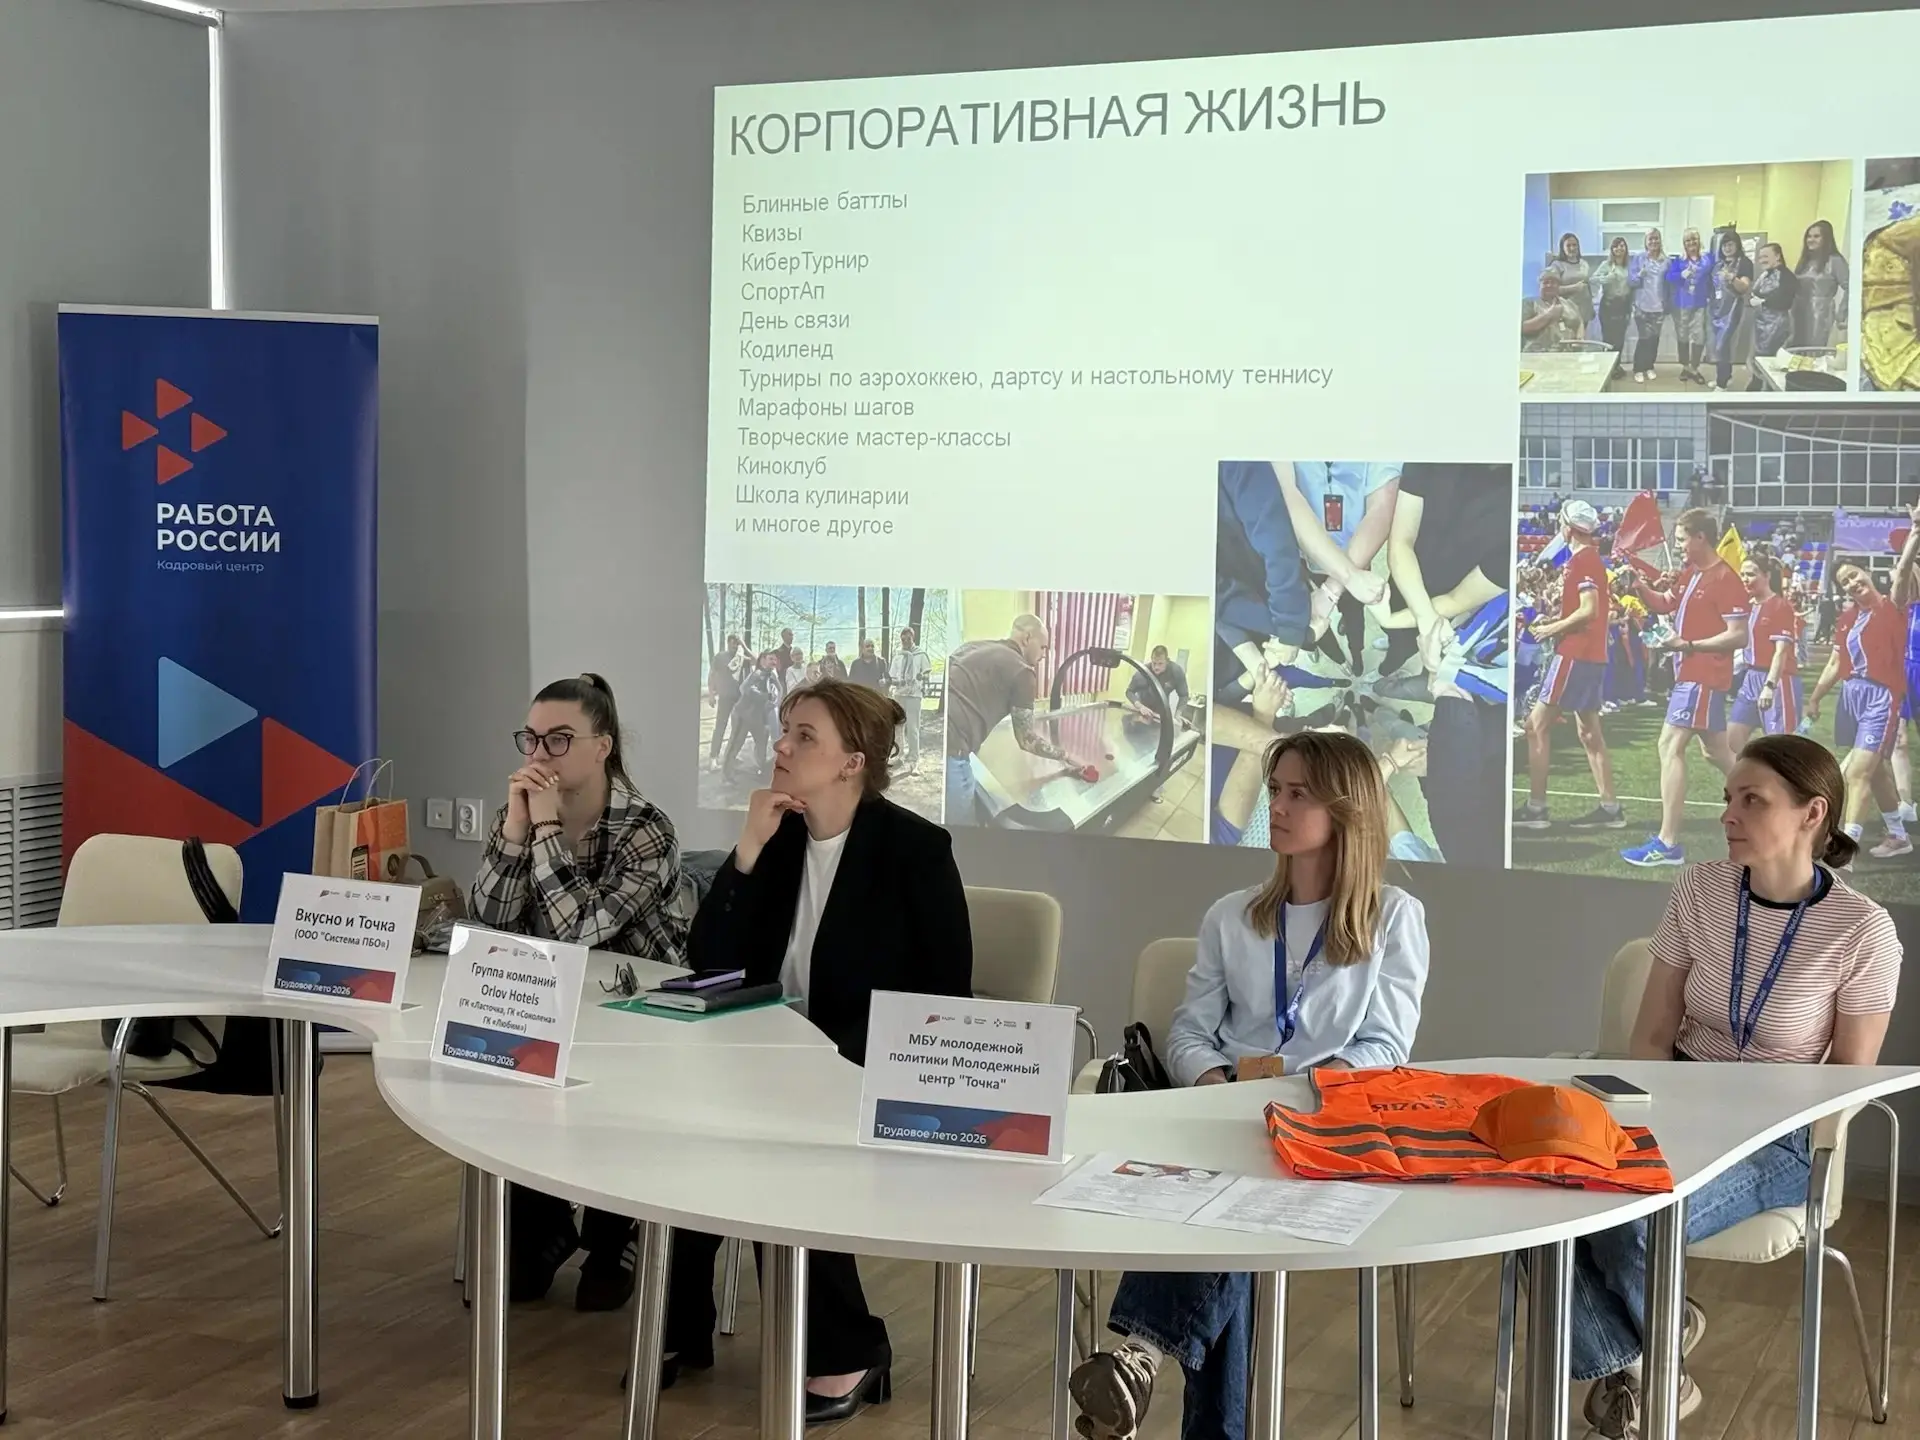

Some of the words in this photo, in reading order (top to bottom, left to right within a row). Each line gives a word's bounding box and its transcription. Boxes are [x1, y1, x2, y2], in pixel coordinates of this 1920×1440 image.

[730, 91, 1168, 156] КОРПОРАТИВНАЯ
[1184, 80, 1387, 135] ЖИЗНЬ
[743, 194, 829, 214] Блинные
[838, 190, 908, 211] баттлы
[742, 223, 803, 244] Квизы
[741, 250, 870, 276] КиберТурнир
[741, 280, 825, 305] СпортАп
[739, 310, 789, 335] День
[794, 312, 850, 330] связи
[740, 339, 834, 363] Кодиленд
[738, 369, 822, 393] Турниры
[829, 372, 853, 389] по
[860, 370, 983, 392] аэрохоккею,
[991, 370, 1064, 391] дартсу
[1071, 370, 1083, 385] и
[1091, 367, 1235, 390] настольному
[1241, 367, 1334, 389] теннису
[738, 397, 847, 422] Марафоны
[854, 401, 915, 417] шагов
[737, 426, 849, 451] Творческие
[856, 430, 1011, 451] мастер-классы
[737, 455, 828, 480] Киноклуб
[735, 484, 800, 505] Школа
[805, 488, 909, 510] кулинарии
[157, 502, 275, 527] РАБОТА
[157, 529, 280, 552] РОССИИ
[735, 517, 746, 533] и
[753, 517, 821, 534] многое
[826, 518, 894, 540] другое
[157, 559, 223, 573] Кадровый
[226, 562, 265, 574] центр
[295, 907, 342, 926] Вкусно
[345, 917, 355, 927] и
[359, 915, 396, 933] Точка
[294, 928, 319, 940] (ООО
[320, 931, 361, 946] "Система
[276, 978, 313, 991] Трудовое
[313, 984, 332, 994] лето
[332, 985, 352, 996] 2026
[471, 962, 505, 979] Группа
[506, 970, 558, 989] компаний
[481, 984, 508, 1000] Orlov
[508, 988, 541, 1006] Hotels
[444, 1043, 479, 1059] Трудовое
[478, 1052, 496, 1063] лето
[496, 1055, 515, 1067] 2026
[908, 1033, 938, 1047] МБУ
[940, 1037, 1024, 1055] молодежной
[889, 1052, 949, 1066] политики
[951, 1056, 1040, 1076] Молодежный
[918, 1072, 955, 1087] центр
[959, 1074, 1007, 1091] "Точка"
[877, 1123, 930, 1140] Трудовое
[931, 1130, 958, 1142] лето
[959, 1132, 988, 1145] 2026
